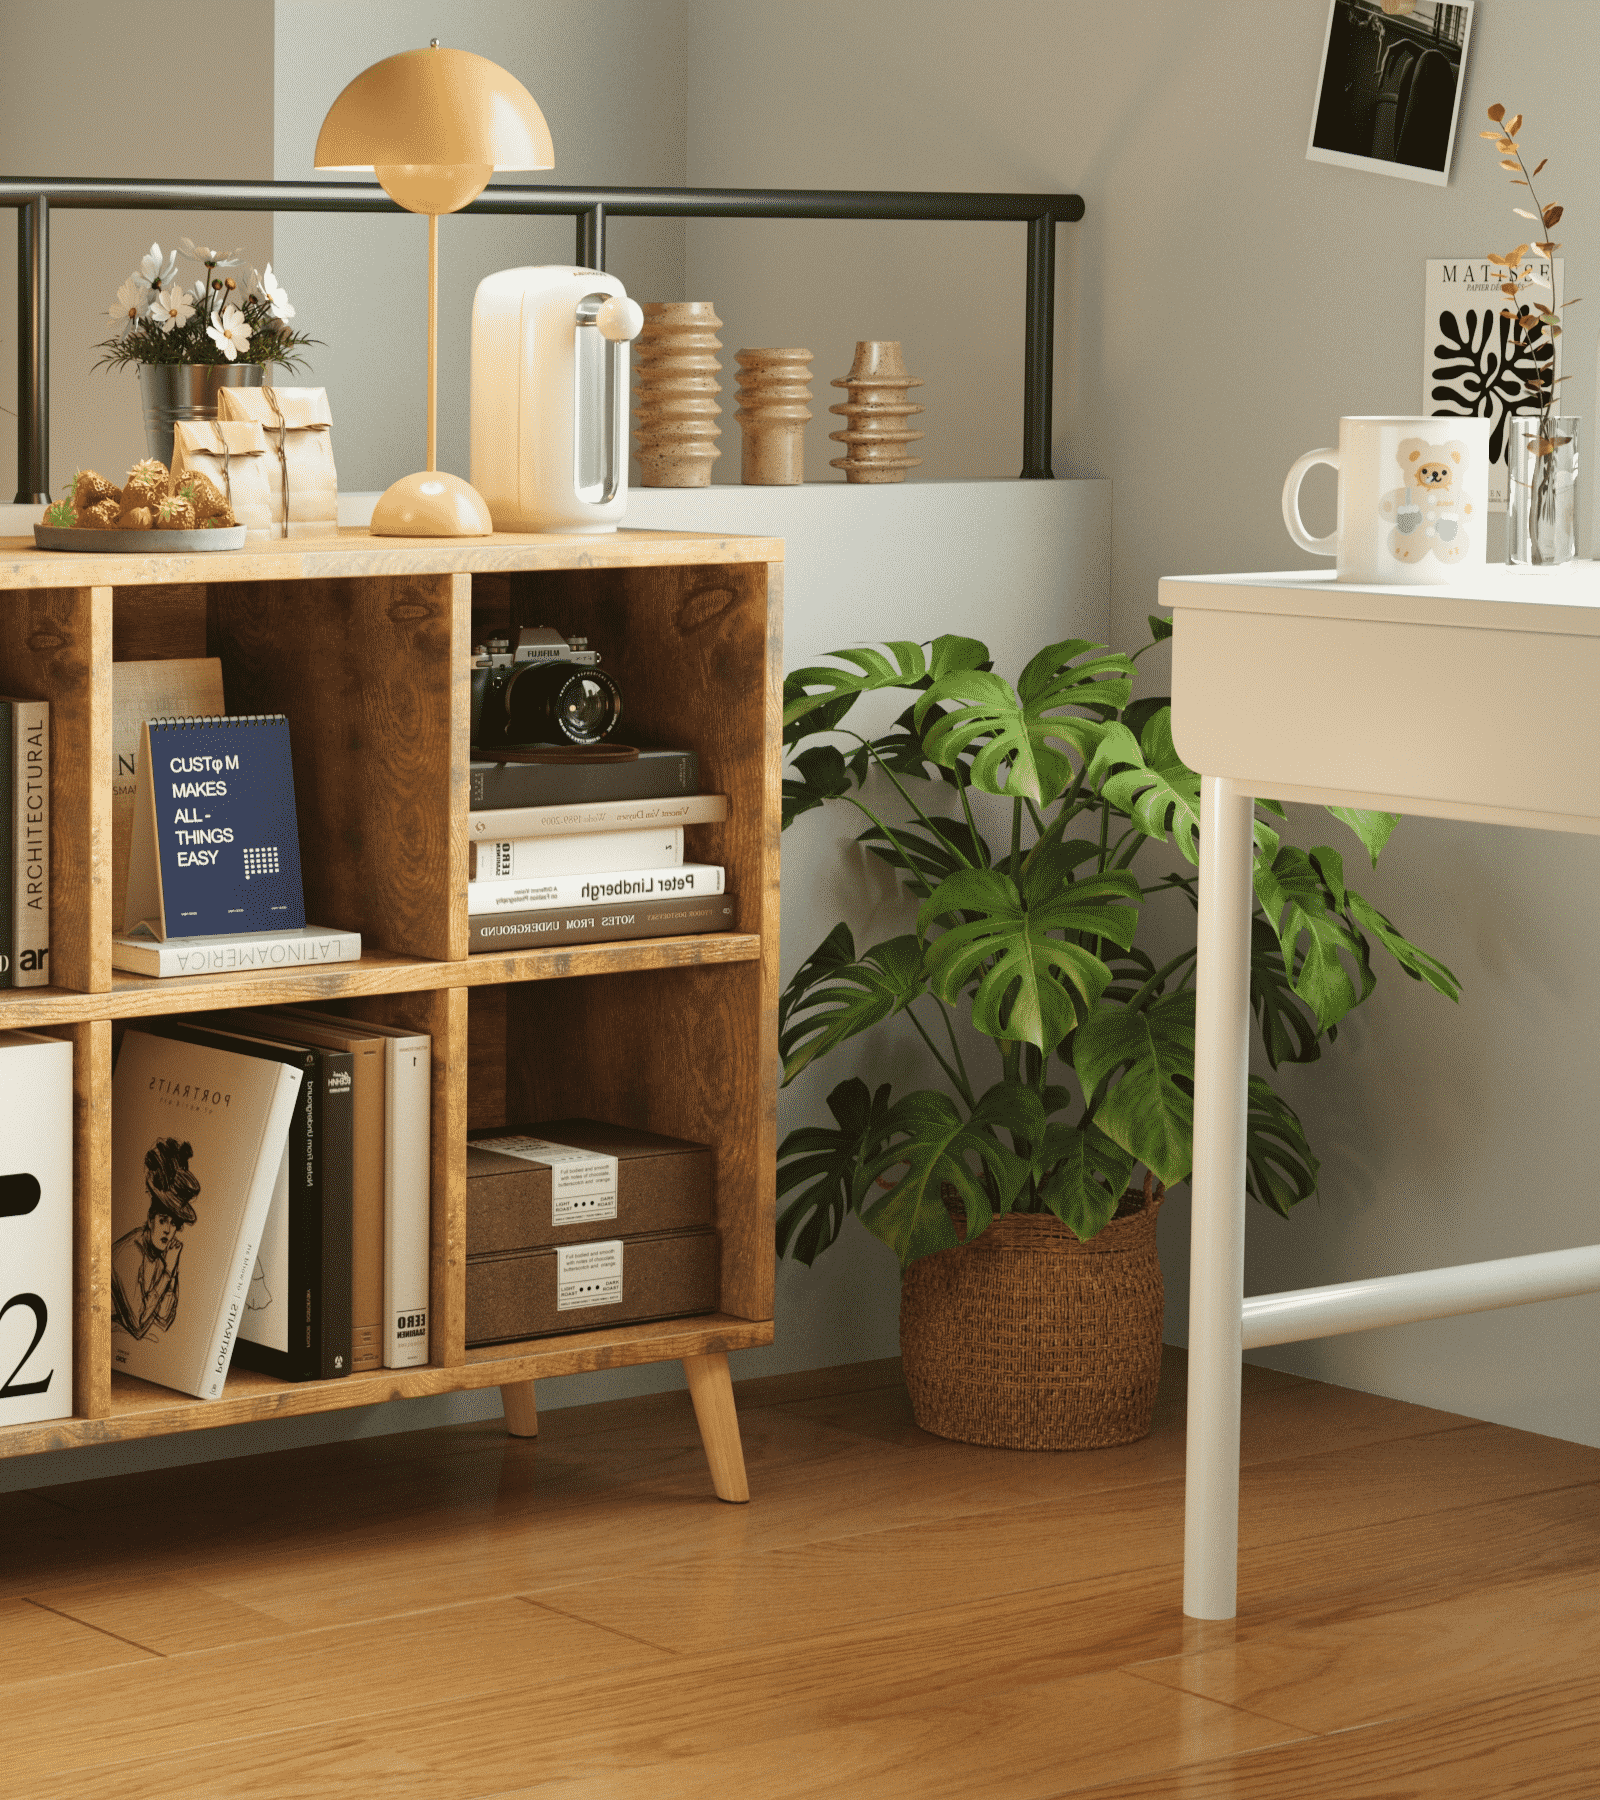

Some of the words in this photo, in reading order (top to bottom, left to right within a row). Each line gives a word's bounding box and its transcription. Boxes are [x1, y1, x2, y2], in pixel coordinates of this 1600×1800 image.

[527, 649, 560, 657] FUJIFILM
[172, 780, 227, 799] MAKES
[27, 719, 43, 910] ARCHITECTURAL
[175, 828, 234, 845] THINGS
[177, 850, 219, 867] EASY
[20, 948, 49, 971] ar
[177, 940, 342, 971] LATINOAMERICA
